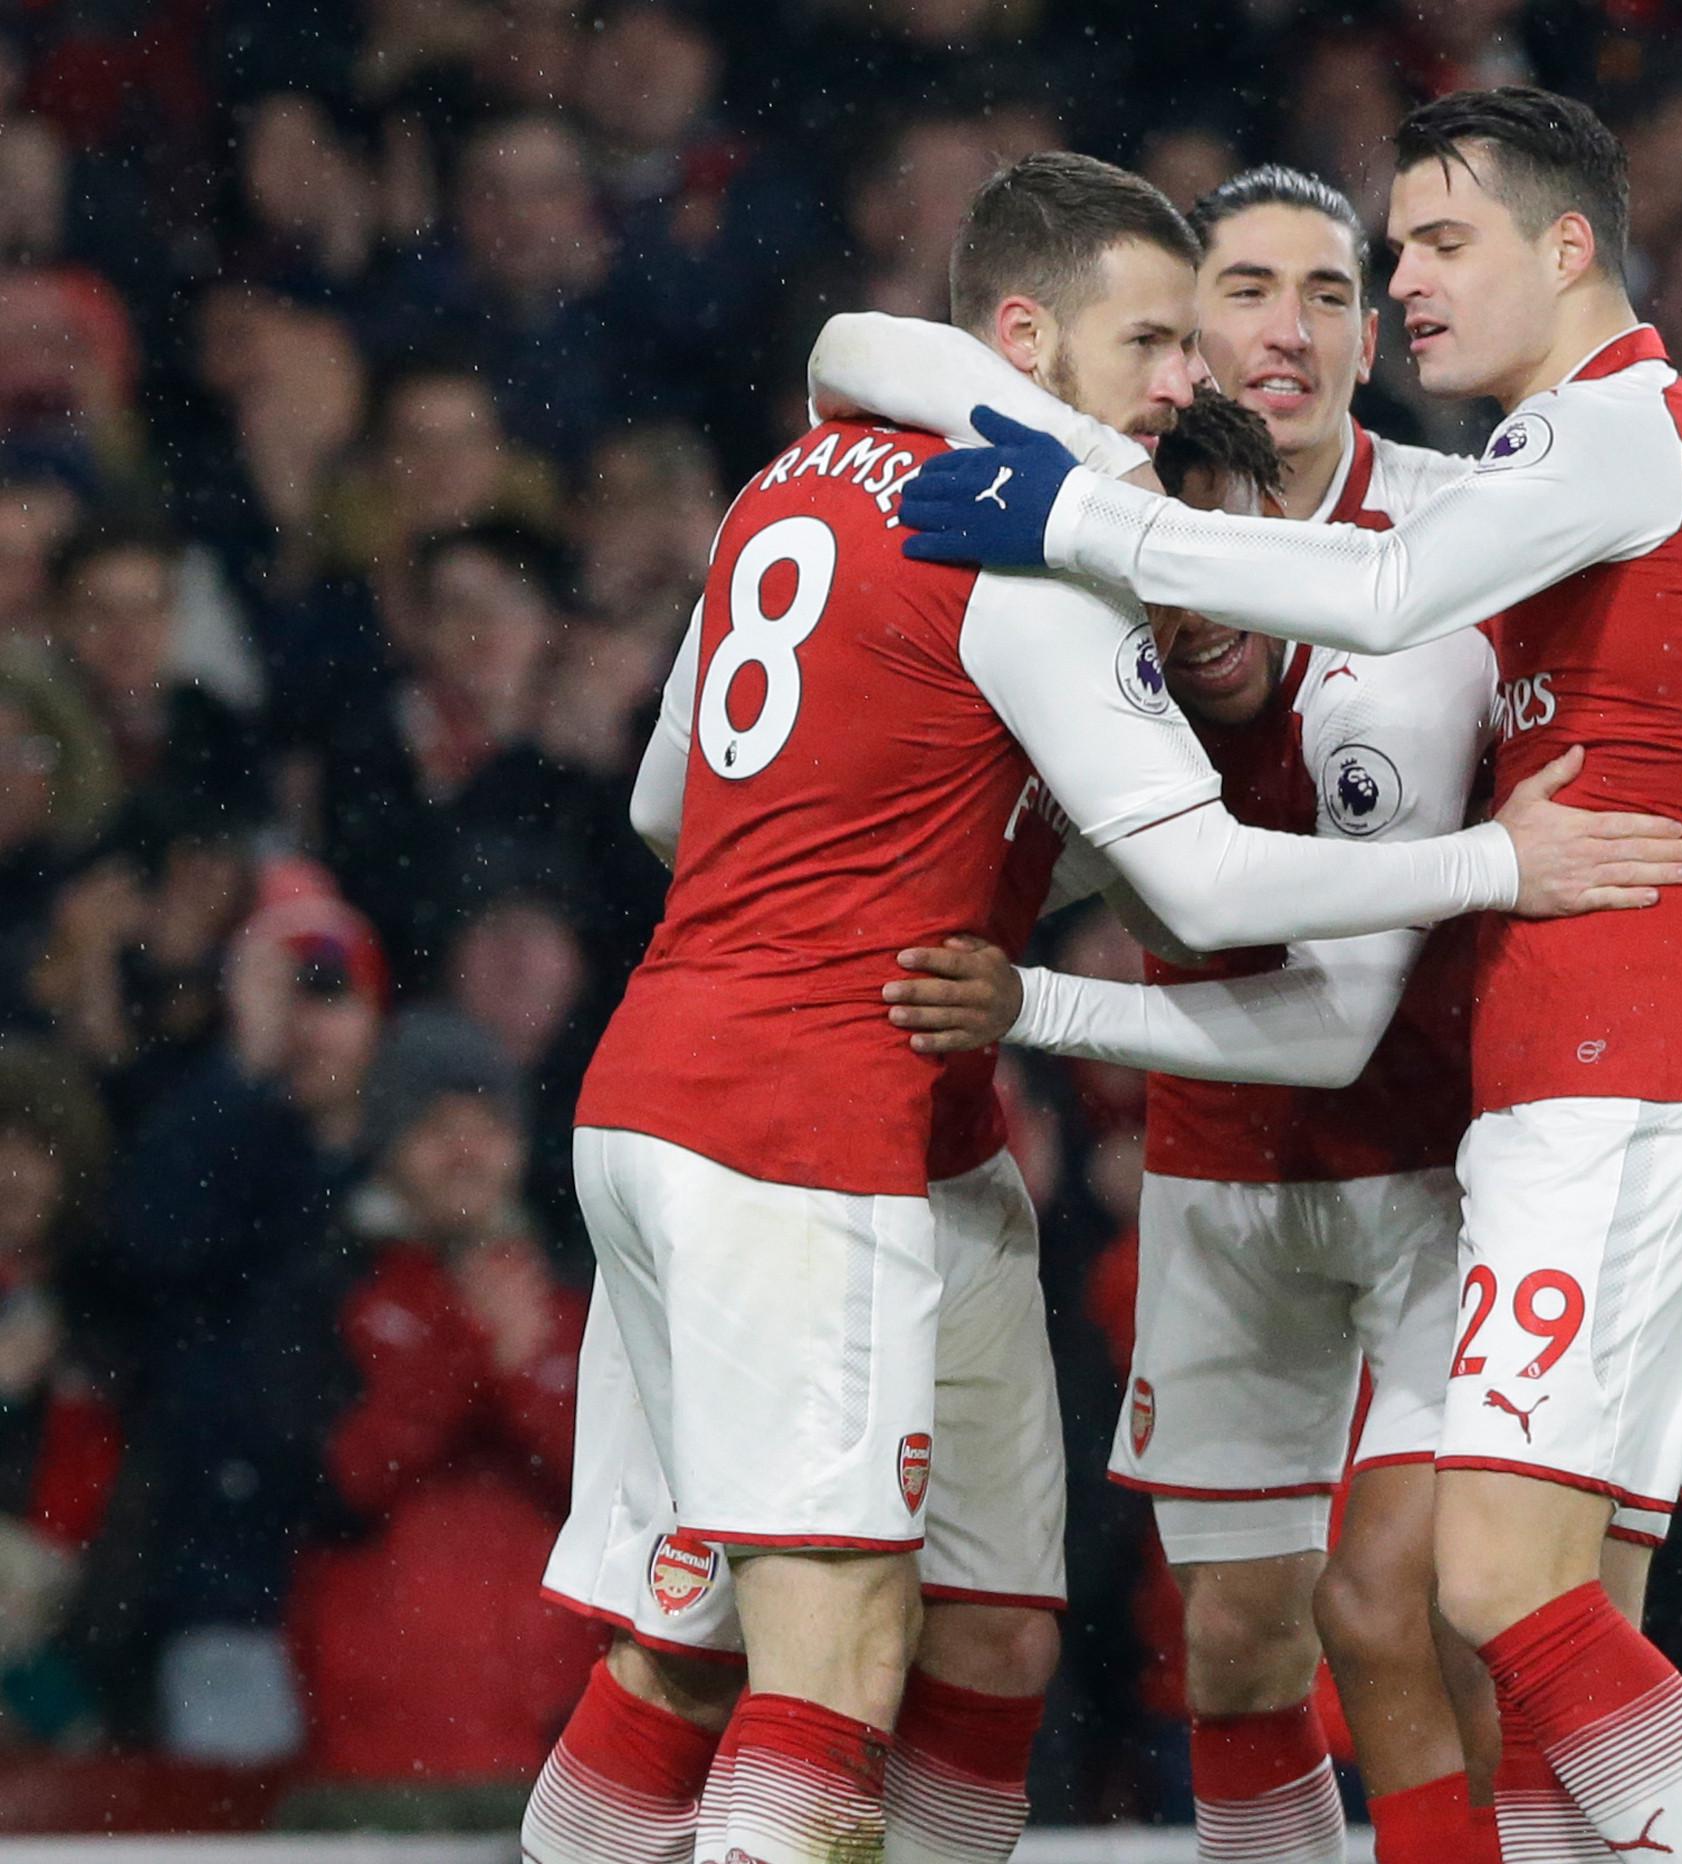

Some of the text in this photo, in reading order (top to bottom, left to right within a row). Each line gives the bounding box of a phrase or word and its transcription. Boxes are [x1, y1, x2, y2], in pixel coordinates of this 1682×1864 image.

[760, 432, 923, 529] RAMSE
[698, 516, 836, 780] 8
[1450, 1264, 1585, 1380] 29
[659, 1542, 710, 1572] Arsenal
